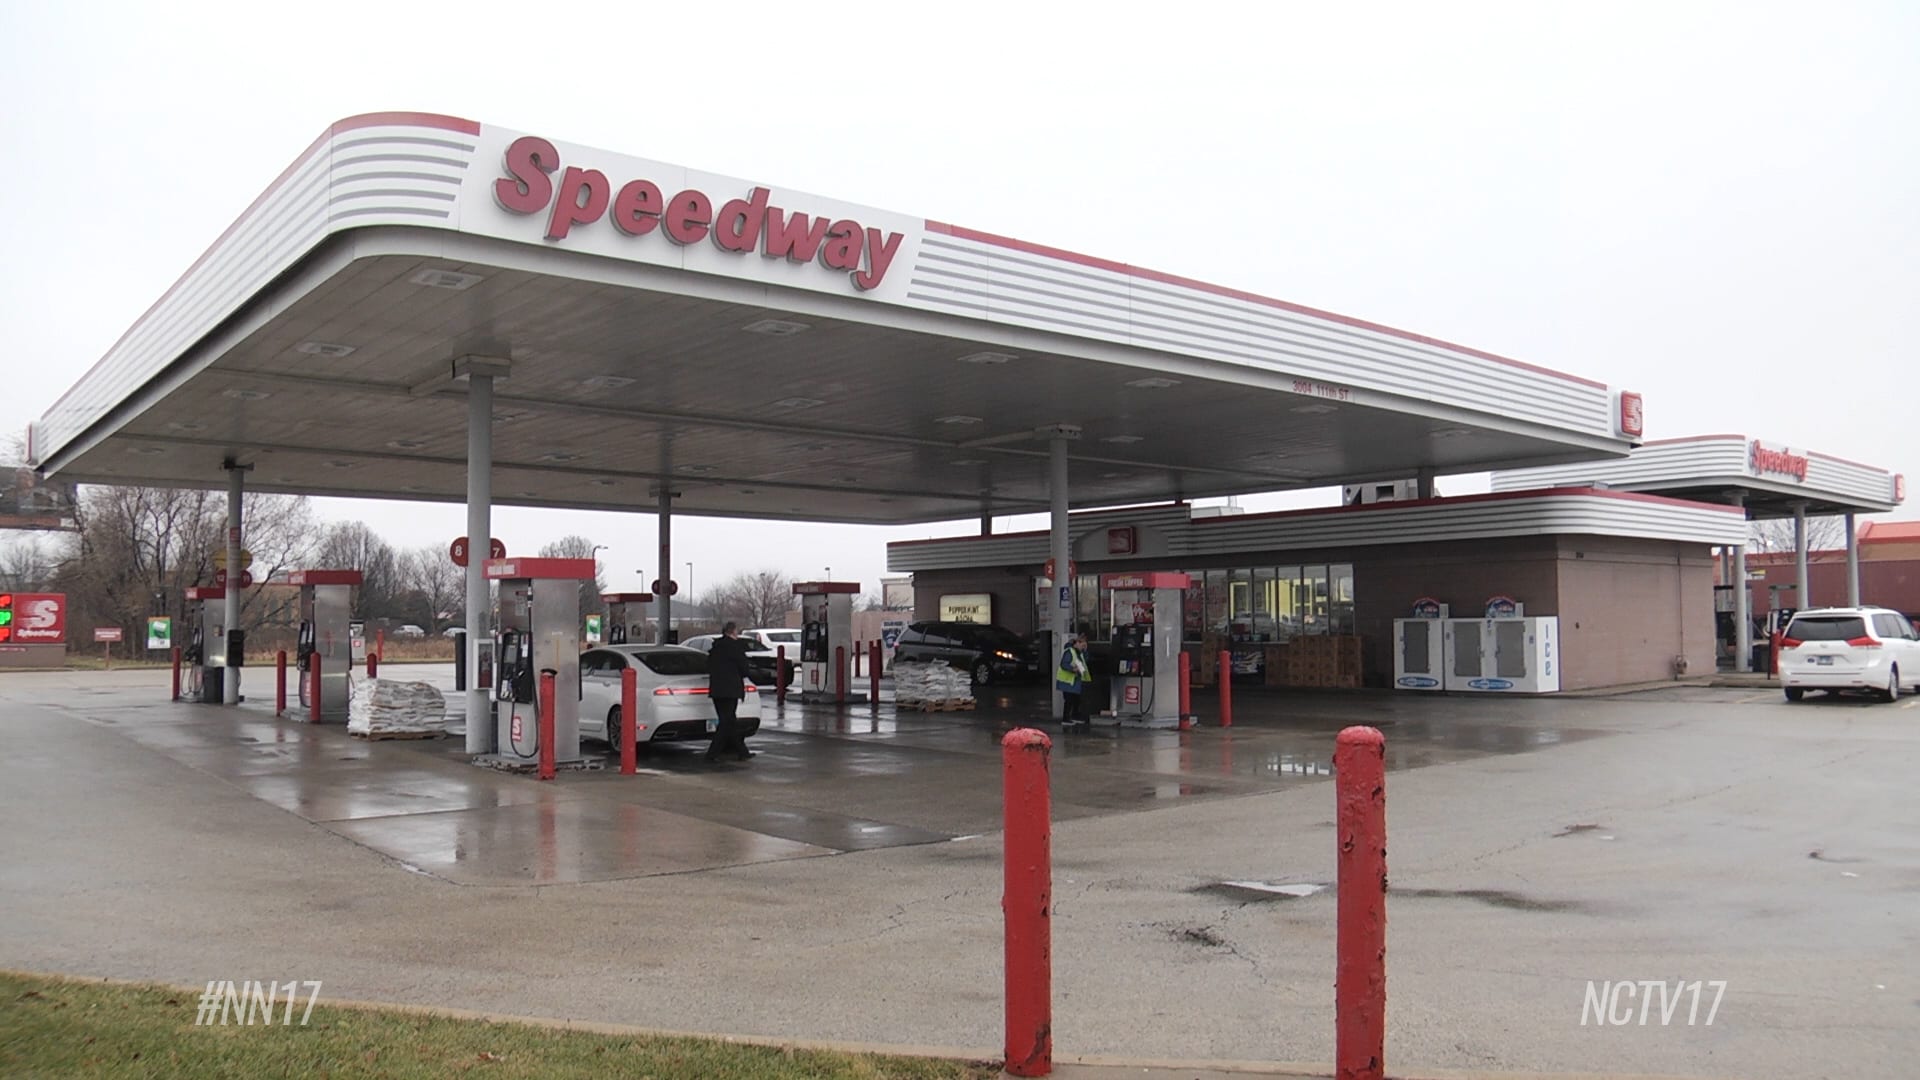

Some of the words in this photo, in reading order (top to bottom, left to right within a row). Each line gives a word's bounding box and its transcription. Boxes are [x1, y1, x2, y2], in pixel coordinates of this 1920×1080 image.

[492, 136, 904, 291] Speedway
[1292, 379, 1312, 394] 3004
[1338, 388, 1349, 400] ST
[1752, 440, 1808, 482] Speedway
[455, 545, 462, 556] 8
[493, 547, 500, 558] 7
[1047, 564, 1053, 574] 2
[29, 600, 58, 628] S
[17, 628, 61, 639] Speedway
